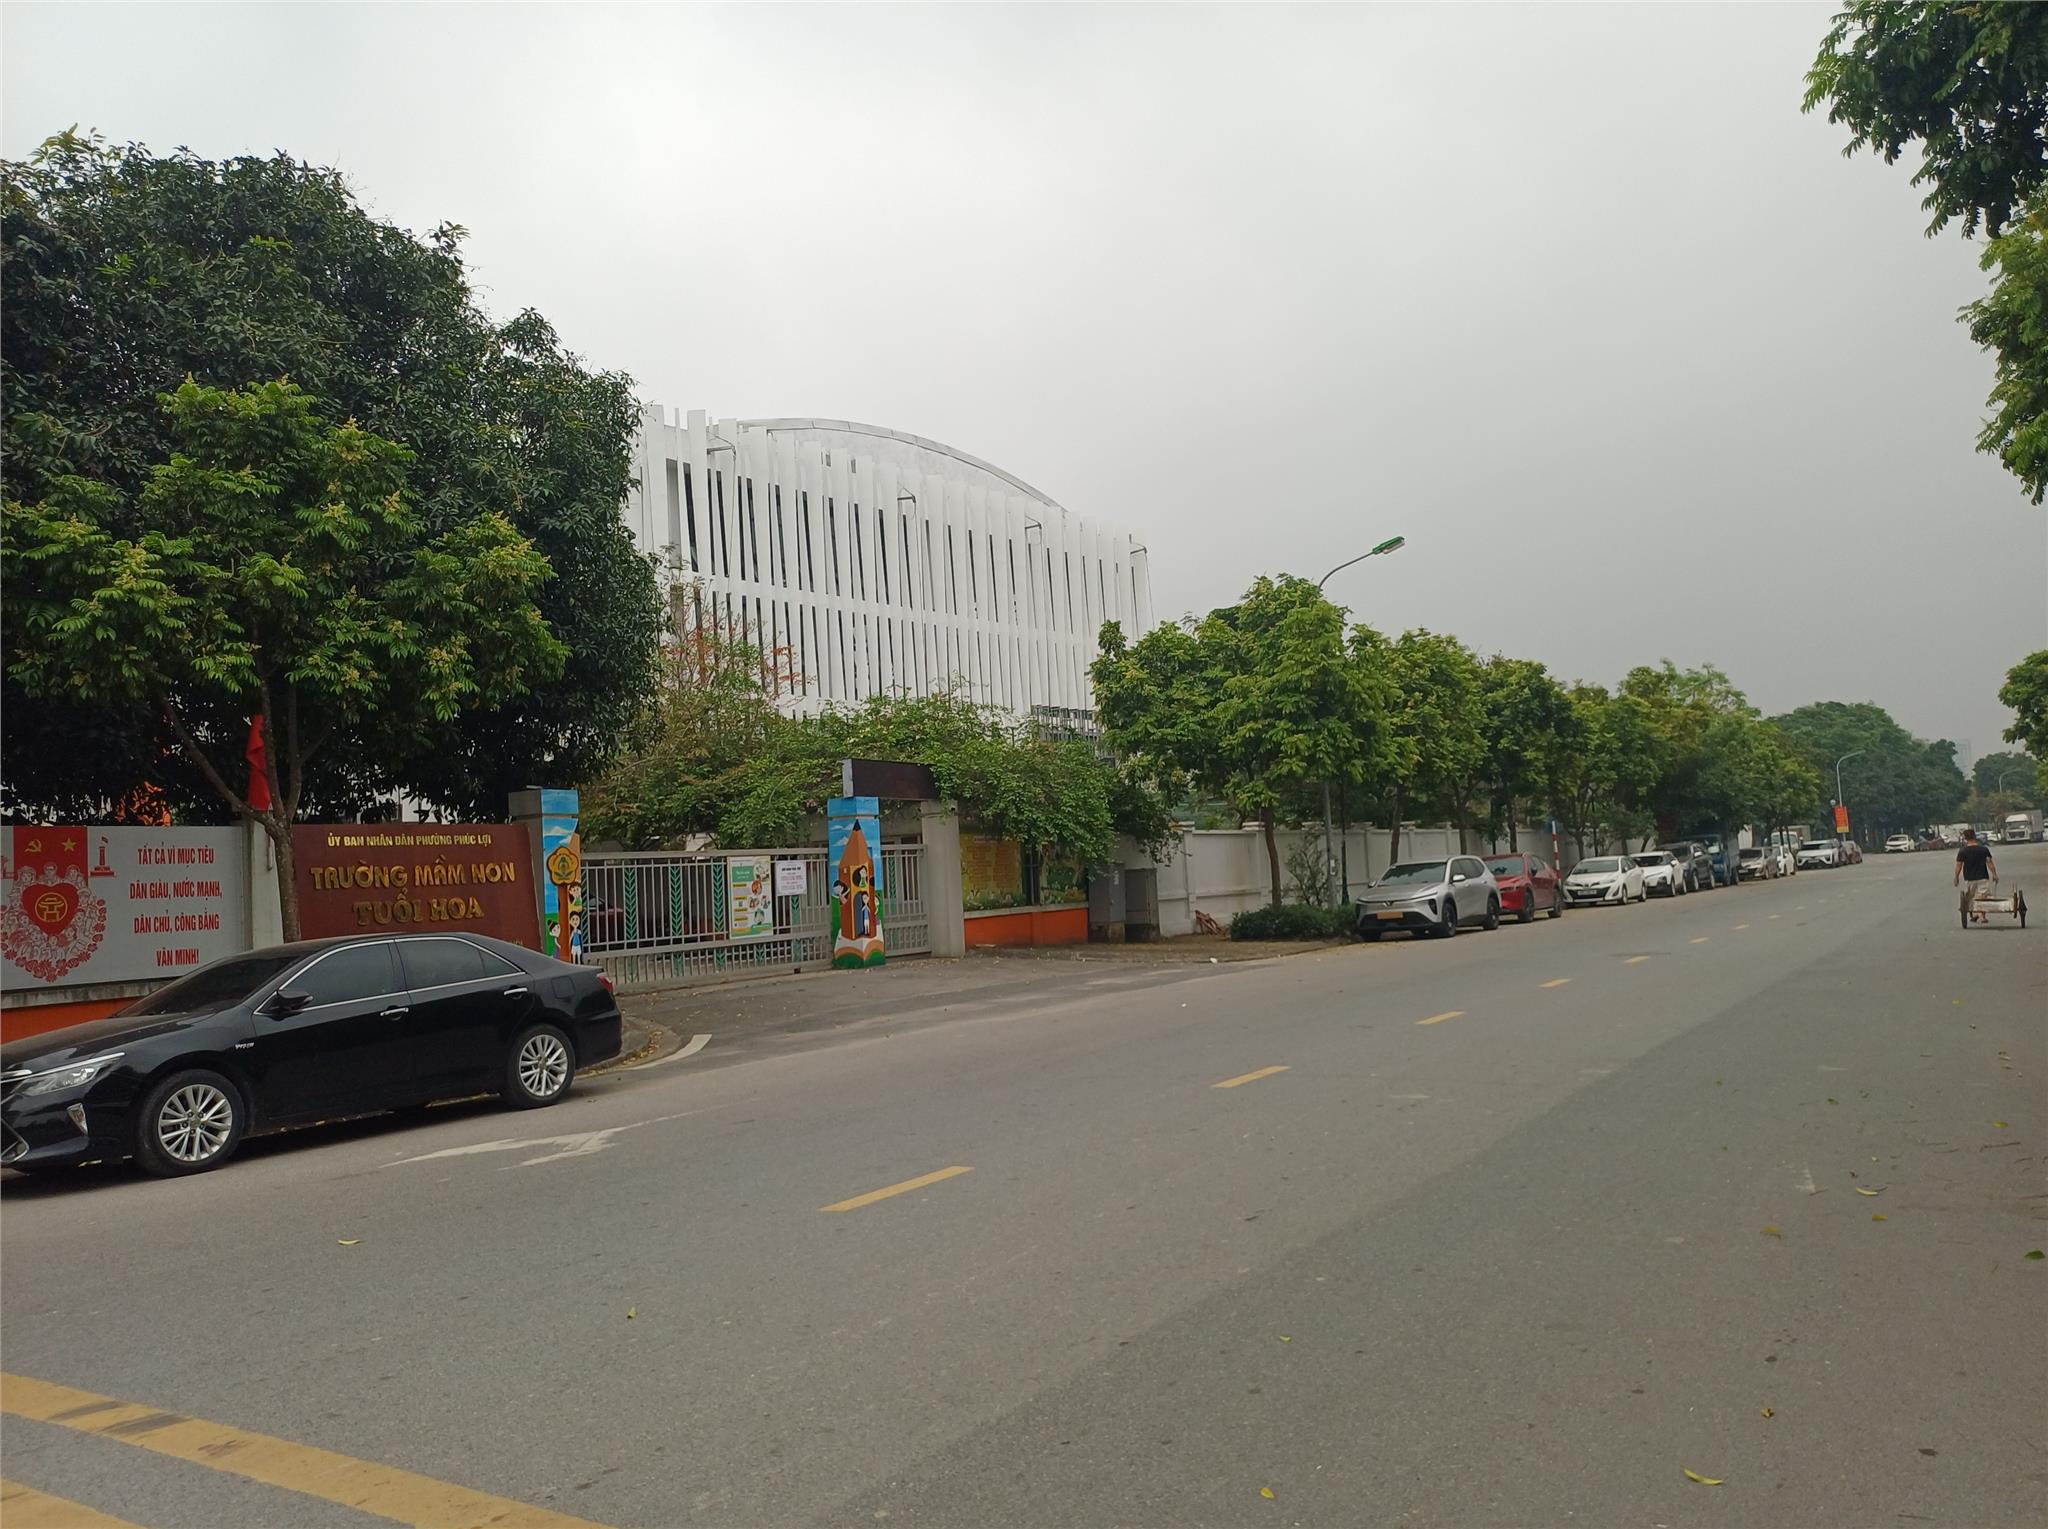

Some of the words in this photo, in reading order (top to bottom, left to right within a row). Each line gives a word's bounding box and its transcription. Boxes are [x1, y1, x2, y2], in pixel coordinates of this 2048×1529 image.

[327, 832, 341, 847] ỦY
[344, 835, 364, 847] BAN
[366, 833, 393, 847] NHÂN
[395, 833, 414, 847] DÂN
[416, 832, 452, 846] PHƯỜNG
[454, 832, 476, 846] PHÚC
[478, 834, 492, 847] LỢI
[137, 842, 152, 865] TẤT
[155, 841, 166, 865] CẢ
[168, 844, 176, 865] VÌ
[178, 847, 195, 868] MỤC
[198, 843, 214, 865] TIÊU
[310, 859, 408, 890] TRƯỜNG
[414, 854, 466, 887] MẦM
[471, 861, 516, 884] NON
[129, 879, 147, 900] DÂN
[149, 879, 171, 899] GIÀU,
[173, 876, 195, 898] NƯỚC
[197, 881, 223, 901] MẠNH,
[134, 913, 152, 934] DÂN
[153, 909, 173, 934] CHỦ,
[175, 911, 196, 932] CÔNG
[198, 906, 220, 931] BẰNG
[353, 887, 422, 926] TUỔI
[428, 896, 485, 921] HOA
[156, 947, 173, 967] VĂN
[175, 948, 199, 966] MINH!
